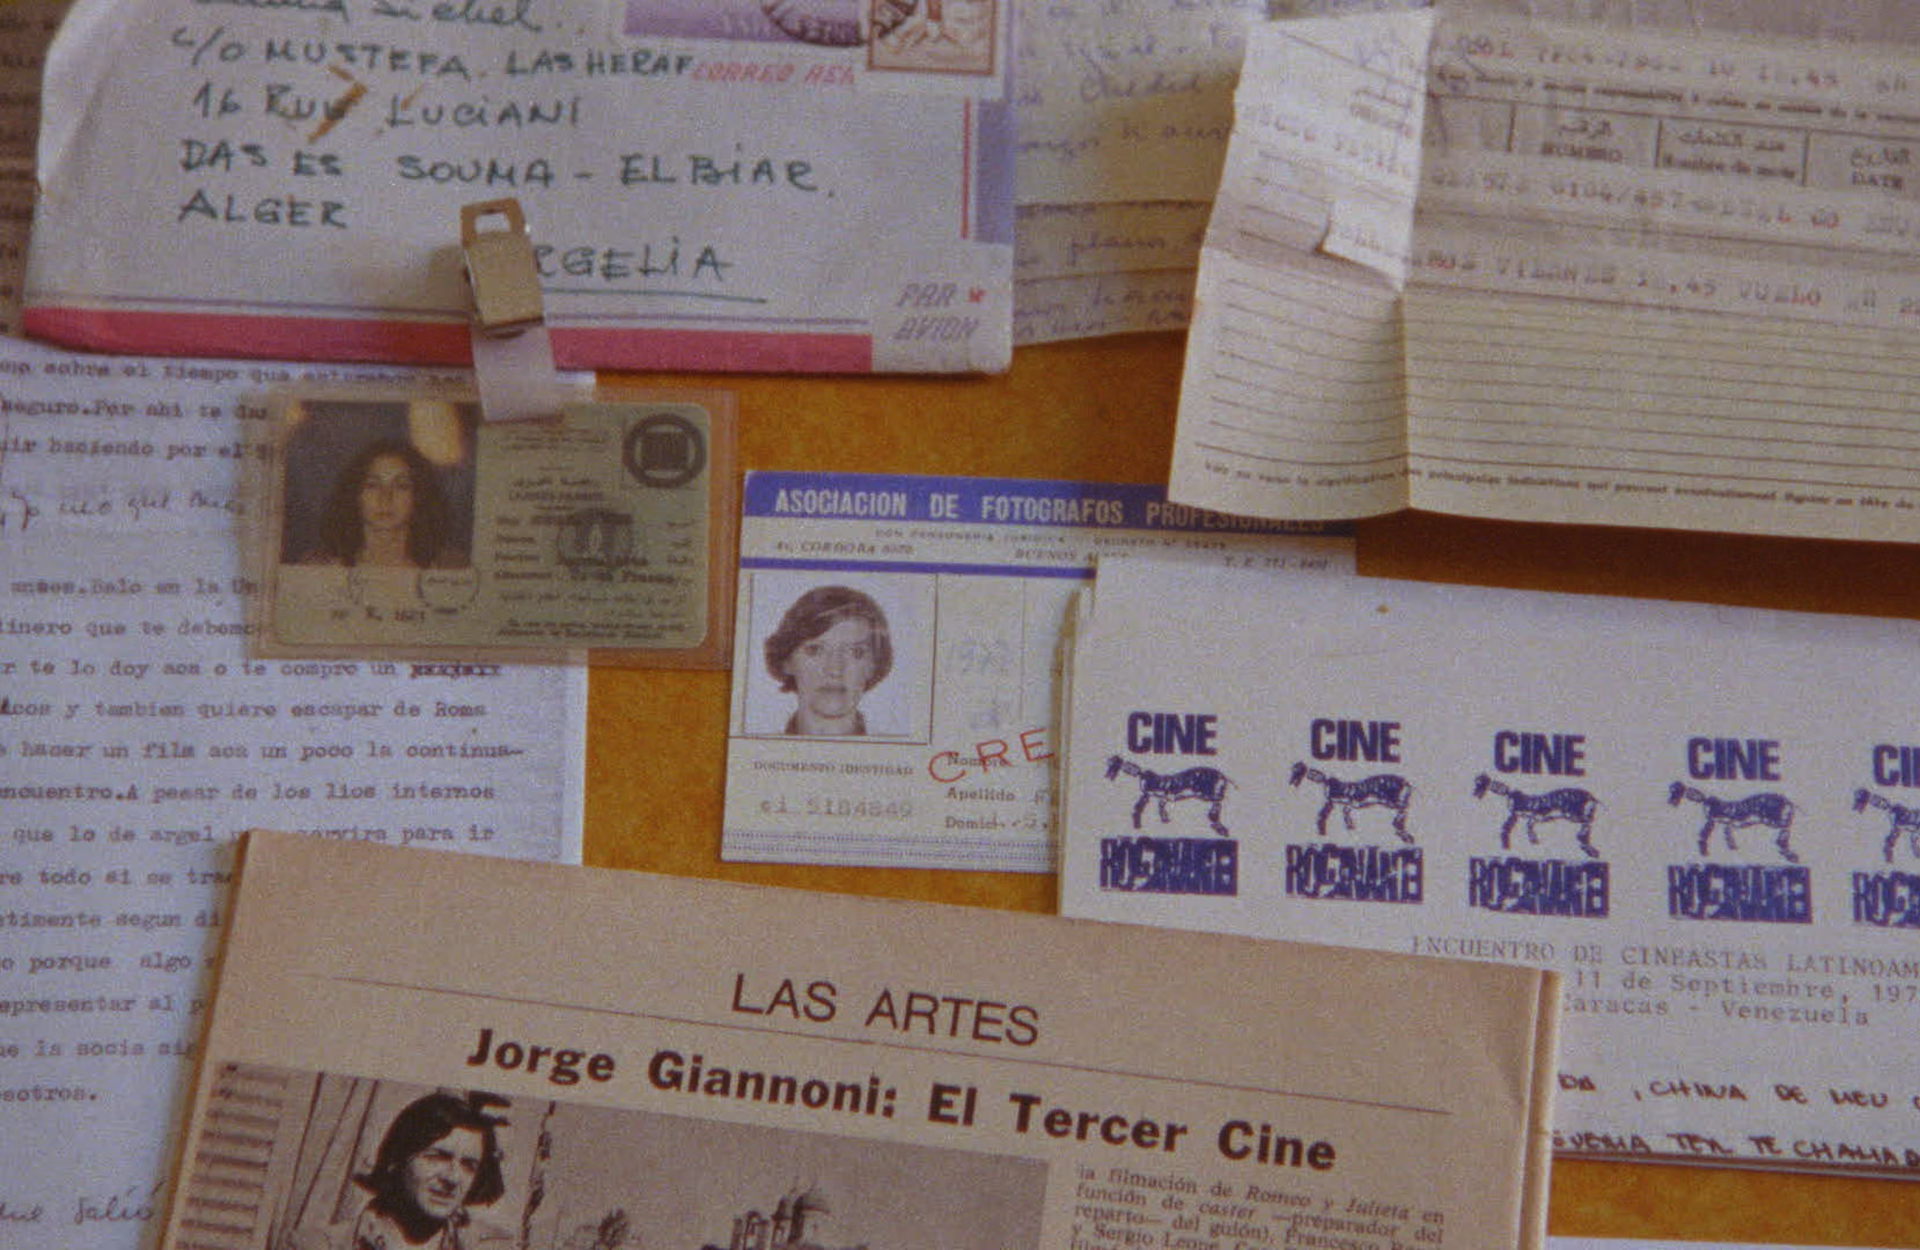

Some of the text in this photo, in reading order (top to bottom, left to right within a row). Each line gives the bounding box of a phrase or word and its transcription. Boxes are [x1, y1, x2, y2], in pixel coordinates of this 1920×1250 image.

[396, 155, 556, 187] SOUMA
[178, 190, 348, 229] ALGER
[775, 487, 907, 519] ASOCIACION
[930, 493, 959, 520] DE
[980, 495, 1124, 526] FOTOGRAFOS
[142, 621, 166, 636] te
[30, 658, 56, 675] te
[70, 659, 96, 676] lo
[110, 659, 150, 679] doy
[280, 663, 359, 680] compro
[370, 662, 397, 676] un
[95, 700, 186, 717] tambien
[196, 702, 277, 719] quiere
[393, 700, 421, 717] de
[1127, 711, 1218, 755] CINE
[1310, 718, 1401, 763] CINE
[142, 741, 196, 759] film
[260, 746, 289, 759] un
[300, 746, 354, 765] poco
[367, 740, 393, 759] la
[1494, 730, 1586, 776] CINE
[1687, 737, 1781, 781] CINE
[839, 762, 915, 778] IDENTIDAD
[231, 783, 258, 800] de
[273, 783, 311, 800] los
[325, 783, 377, 800] lios
[391, 783, 496, 800] internos
[946, 786, 1017, 804] Apellido
[12, 829, 54, 845] que
[69, 825, 96, 843] lo
[108, 826, 137, 843] de
[38, 867, 92, 885] todo
[28, 957, 112, 975] porque
[140, 953, 192, 974] algo
[1572, 944, 1604, 963] DE
[1620, 944, 1769, 972] CINEASTAS
[1621, 969, 1653, 991] de
[731, 973, 1040, 1046] LAS ARTES
[1720, 999, 1870, 1027] Venezuela
[466, 1028, 1336, 1172] Jorge Giannoni: El Tercer Cine
[1109, 1167, 1198, 1194] filmación
[1211, 1181, 1233, 1197] de
[1245, 1184, 1312, 1207] Romeo
[1346, 1196, 1411, 1221] Julieta
[1421, 1210, 1444, 1225] en
[1075, 1183, 1148, 1206] función
[1161, 1196, 1186, 1211] de
[1414, 1225, 1444, 1245] del
[1171, 1215, 1200, 1233] del
